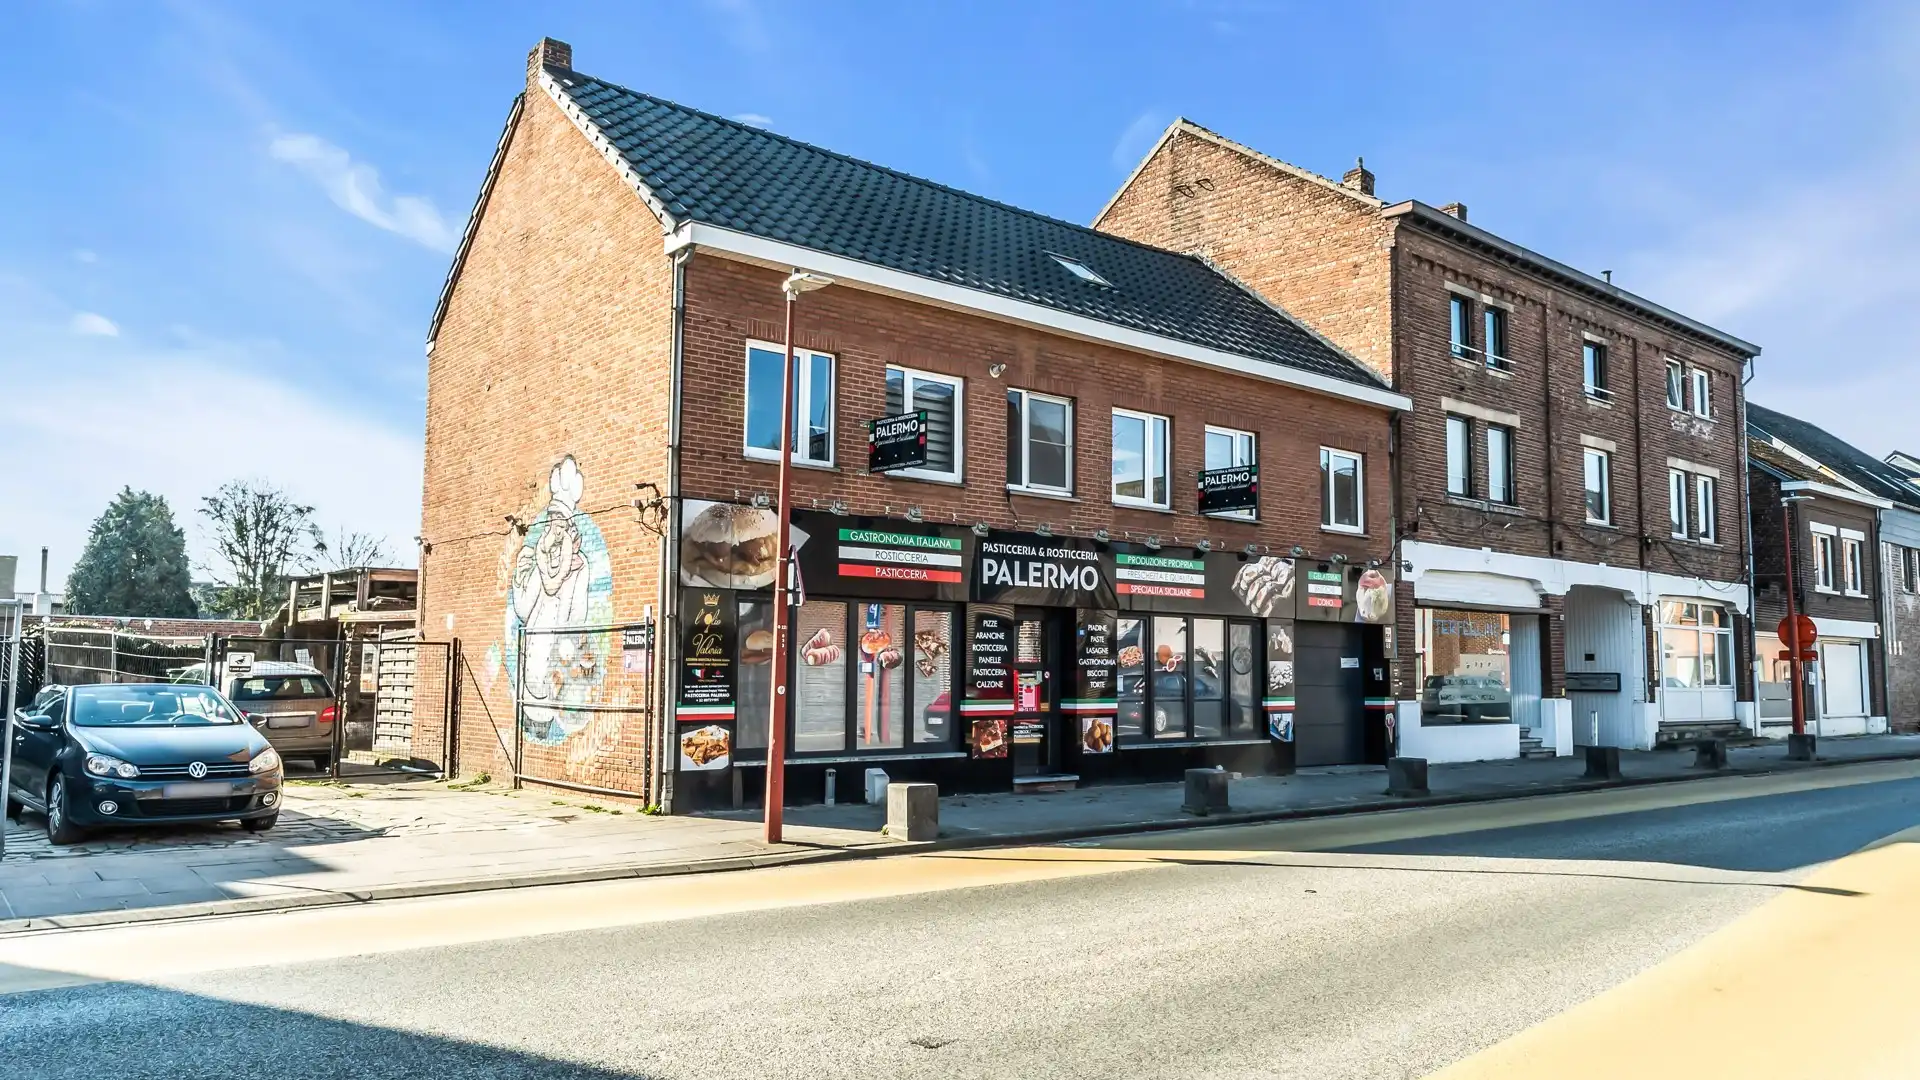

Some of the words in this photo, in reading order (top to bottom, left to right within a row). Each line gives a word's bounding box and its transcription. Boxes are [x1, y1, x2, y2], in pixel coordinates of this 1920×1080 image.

[876, 420, 918, 438] PALERMO
[1205, 472, 1249, 485] PALERMO
[850, 531, 915, 546] GASTRONOMIA
[916, 538, 952, 549] ITALIANA
[982, 542, 1037, 556] PASTICCERIA
[1038, 547, 1045, 557] &
[1046, 548, 1099, 560] ROSTICCERIA
[875, 550, 928, 563] ROSTICCERIA
[1127, 555, 1168, 567] PRODUZIONE
[1168, 560, 1194, 569] PROPRIA
[875, 567, 928, 579] PASTICCERIA
[982, 558, 1099, 591] PALERMO
[1164, 588, 1192, 597] SICILIANE
[983, 620, 998, 628] PIZZE
[1087, 624, 1107, 632] PIADINE
[975, 631, 1005, 640] ARANCINE
[1090, 635, 1105, 643] PASTE
[692, 633, 723, 657] Valeria
[972, 644, 1008, 652] ROSTICCERIA
[1086, 647, 1109, 655] LASAGNE
[978, 656, 1001, 664] PANELLE
[1078, 658, 1116, 666] GASTRONOMIA
[972, 668, 1007, 676] PASTICCERIA
[1086, 669, 1109, 677] BISCOTTI
[976, 680, 1004, 688] CALZONE
[1089, 681, 1106, 689] TORTE
